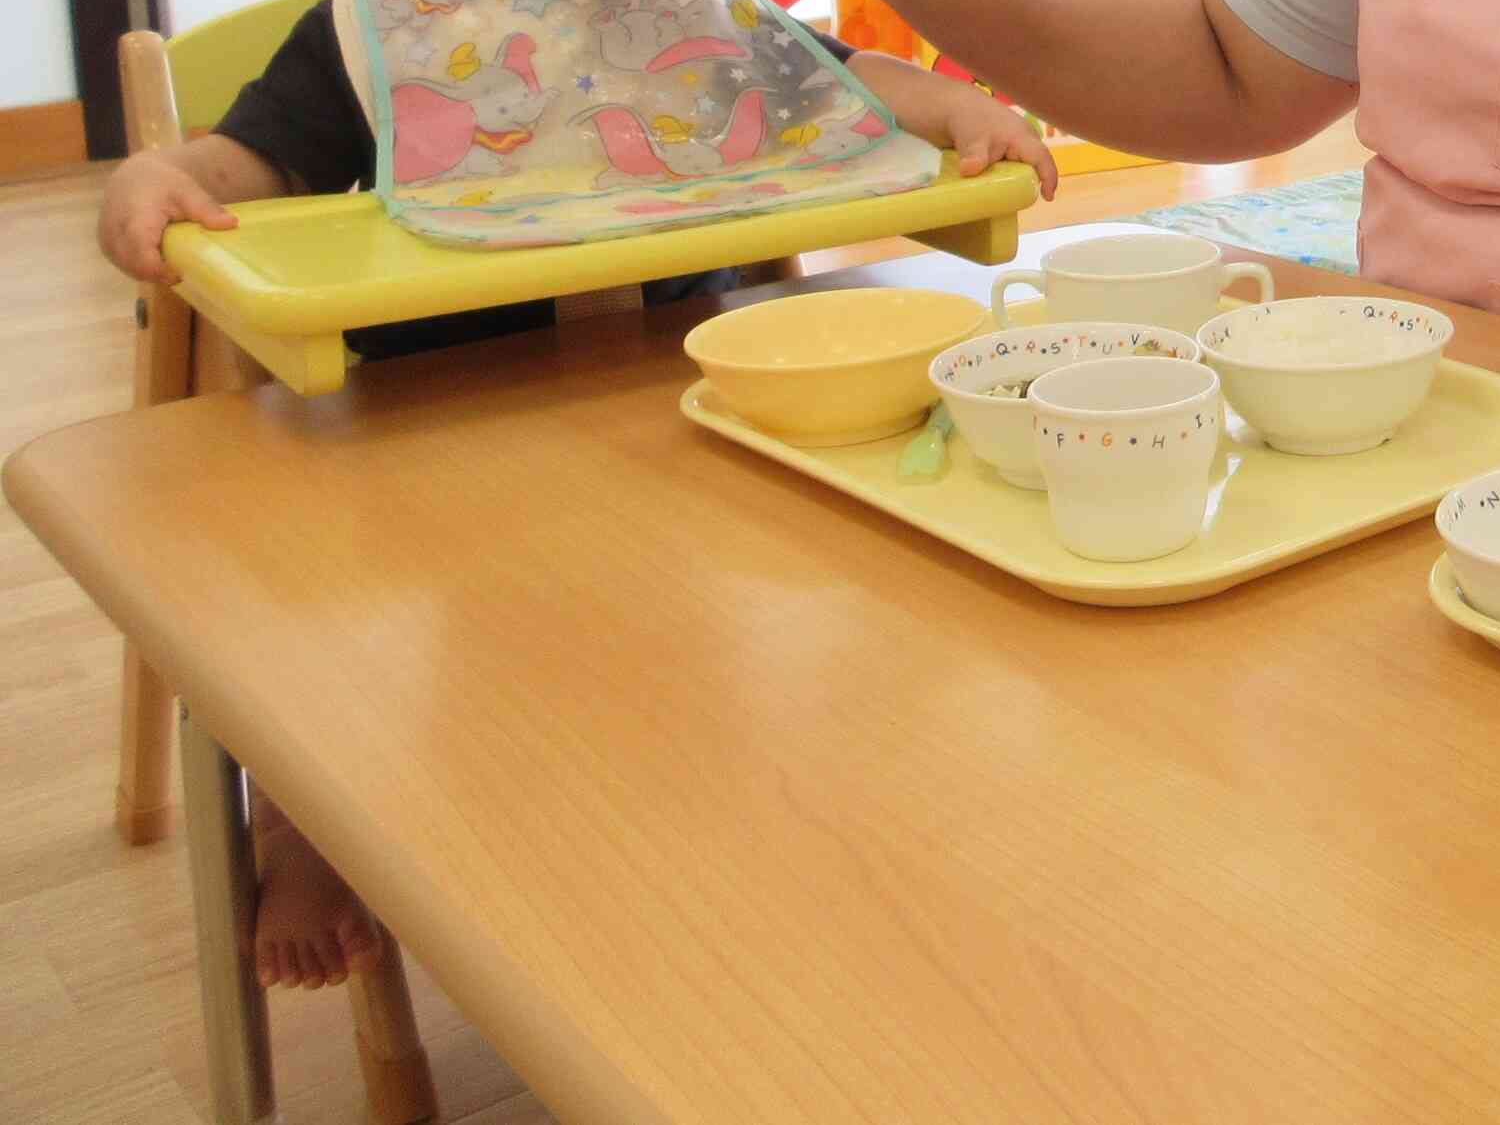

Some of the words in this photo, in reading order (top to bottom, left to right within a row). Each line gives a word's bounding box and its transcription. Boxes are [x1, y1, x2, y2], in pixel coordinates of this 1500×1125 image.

[996, 343, 1010, 355] Q
[1050, 342, 1061, 354] S
[1077, 335, 1088, 347] T
[1102, 342, 1113, 355] U
[1131, 334, 1140, 345] V
[1057, 433, 1065, 450] F
[1102, 432, 1112, 449] G
[1152, 435, 1166, 449] H
